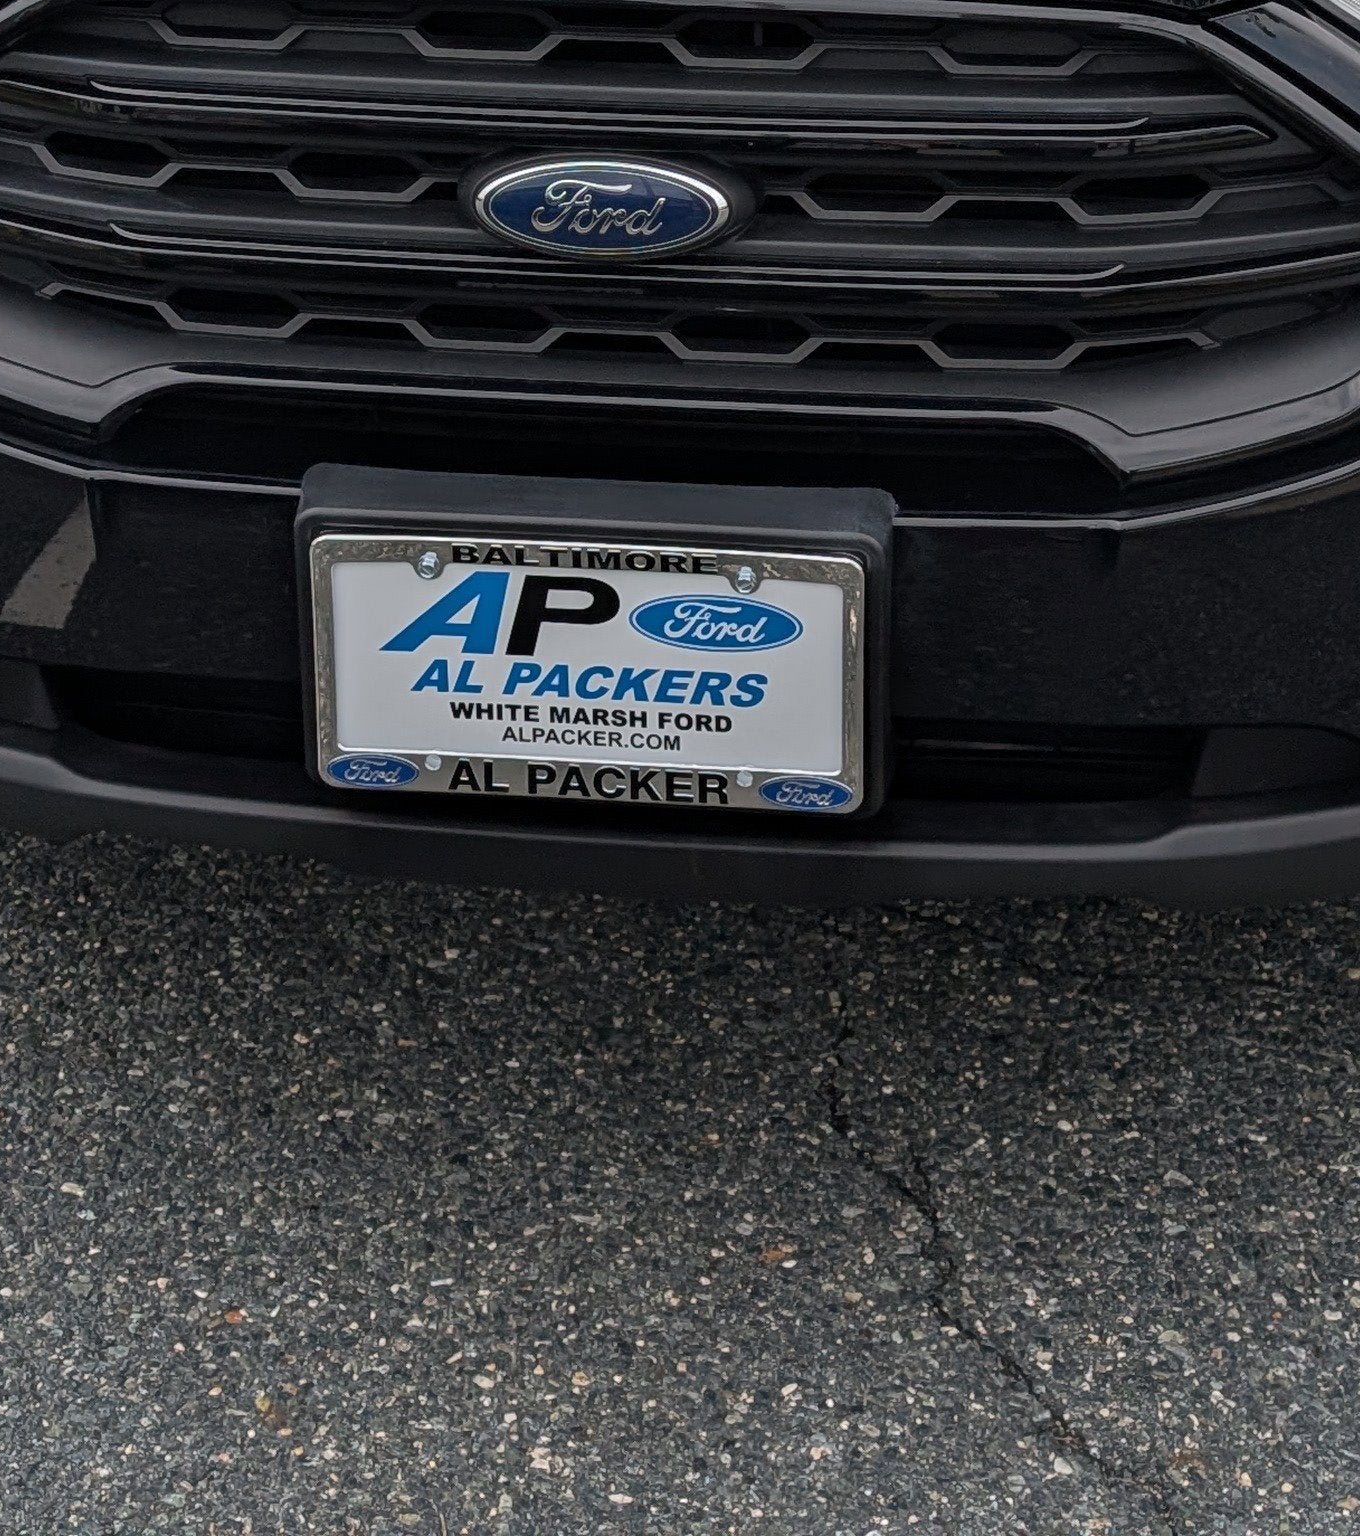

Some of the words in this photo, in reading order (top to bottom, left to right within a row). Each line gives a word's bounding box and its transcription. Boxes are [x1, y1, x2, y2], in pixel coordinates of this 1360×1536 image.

[531, 179, 666, 235] Ford
[451, 543, 720, 575] BALTIMORE
[379, 570, 620, 656] AP
[664, 600, 768, 644] Ford
[411, 659, 484, 694] AL
[502, 662, 768, 708] PACKERS
[450, 702, 540, 723] WHITE
[549, 707, 648, 729] MARSH
[658, 712, 732, 733] FORD
[501, 727, 681, 751] ALPACKER.COM
[344, 760, 401, 784] Ford
[448, 758, 510, 793] AL
[527, 761, 729, 805] PACKER
[776, 781, 835, 806] Ford
